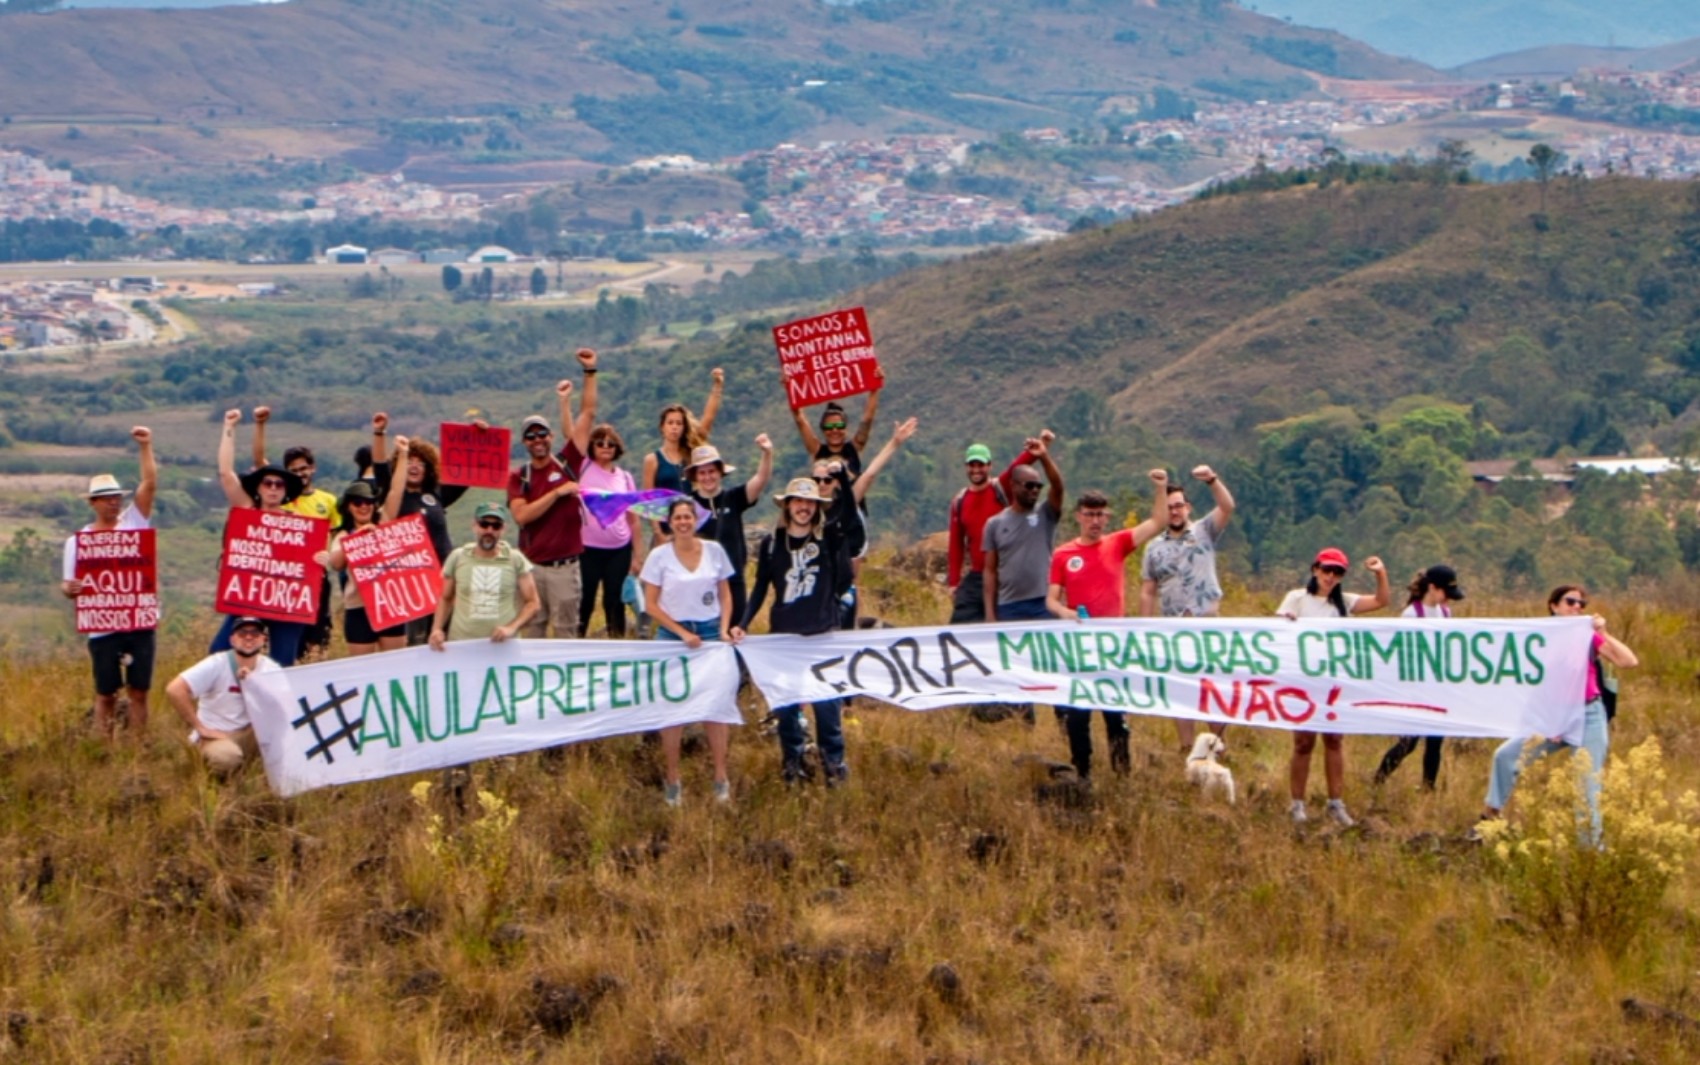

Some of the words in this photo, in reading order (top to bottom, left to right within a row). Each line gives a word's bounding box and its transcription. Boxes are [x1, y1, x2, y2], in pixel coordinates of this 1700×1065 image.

[777, 315, 842, 343] SOMOS
[847, 312, 858, 328] A
[780, 329, 866, 361] MONTANHA
[783, 359, 807, 376] QUE
[812, 351, 842, 371] ELES
[789, 362, 865, 405] MOER!
[246, 524, 306, 547] MUDAR
[261, 513, 315, 533] QUEREM
[78, 531, 141, 546] QUEREM
[228, 538, 273, 558] NOSSA
[77, 544, 142, 560] MINERAR
[227, 553, 305, 578] IDENTIDADE
[80, 569, 143, 594] AQUI
[222, 573, 245, 601] A
[247, 574, 314, 613] FORÇA
[76, 593, 136, 608] EMBAIXO
[373, 572, 437, 624] AQUI
[77, 607, 132, 631] NOSSOS
[811, 631, 994, 698] FORA
[997, 630, 1280, 676] MINERADORAS
[1299, 630, 1546, 685] CRIMINOSAS
[291, 655, 693, 765] #ANULAPREFEITO
[1068, 676, 1171, 709] AQUI
[1199, 677, 1342, 723] NÃO!
